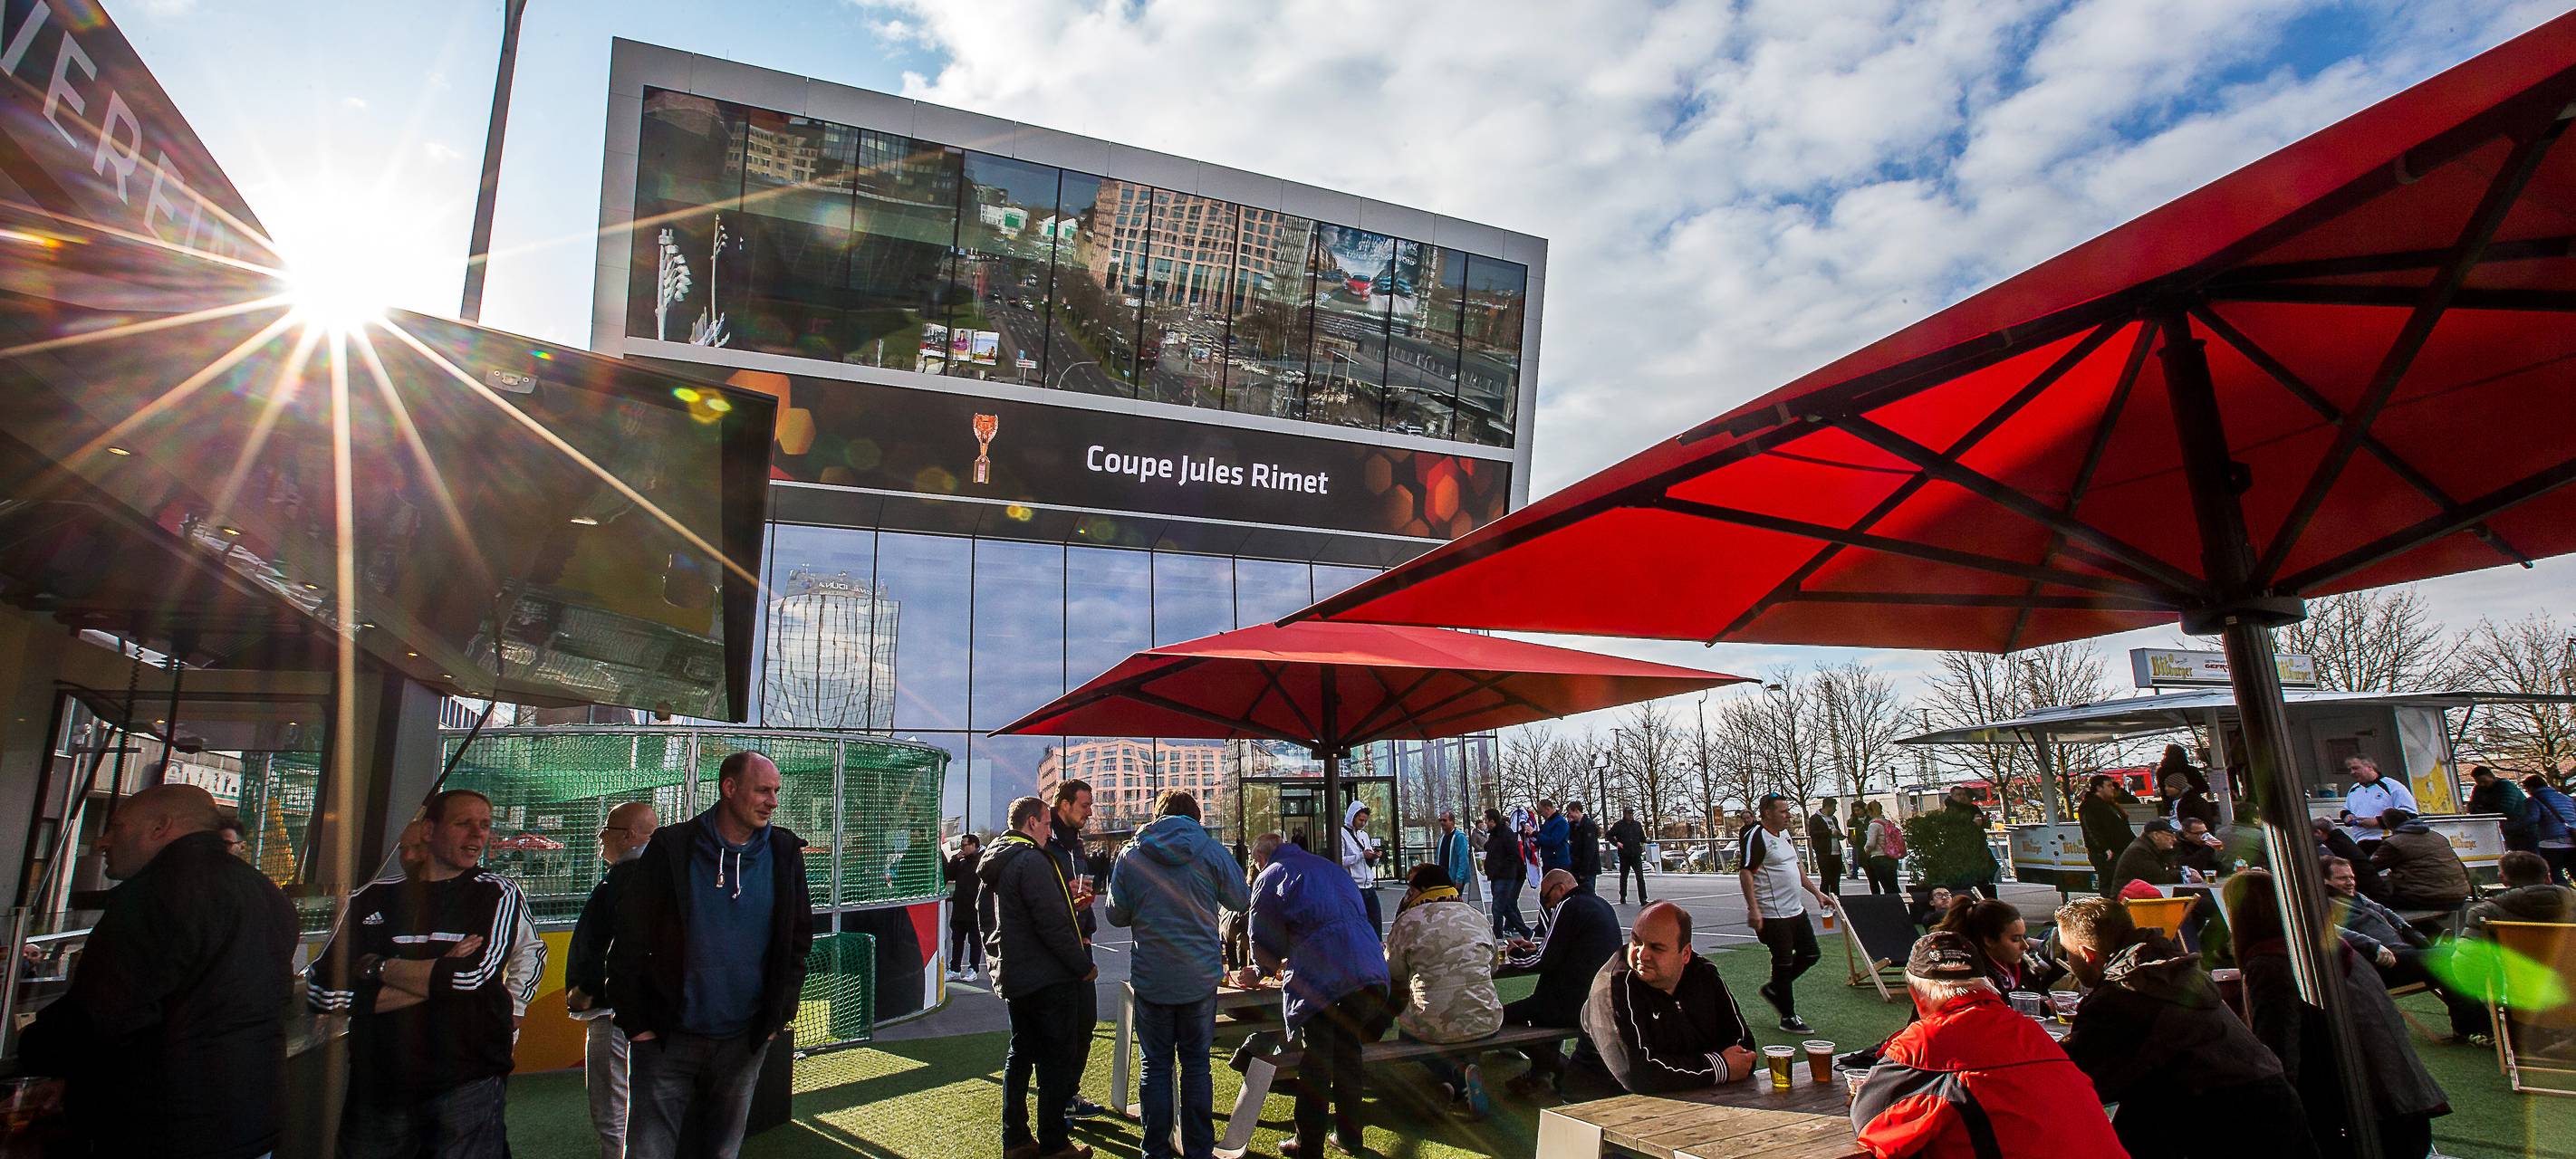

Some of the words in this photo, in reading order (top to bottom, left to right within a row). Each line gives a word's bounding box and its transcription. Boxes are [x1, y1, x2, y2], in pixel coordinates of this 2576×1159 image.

[1087, 445, 1173, 483] Coupe
[1178, 455, 1244, 486] Jules
[1251, 463, 1329, 494] Rimet
[2150, 654, 2193, 677] Bitburger
